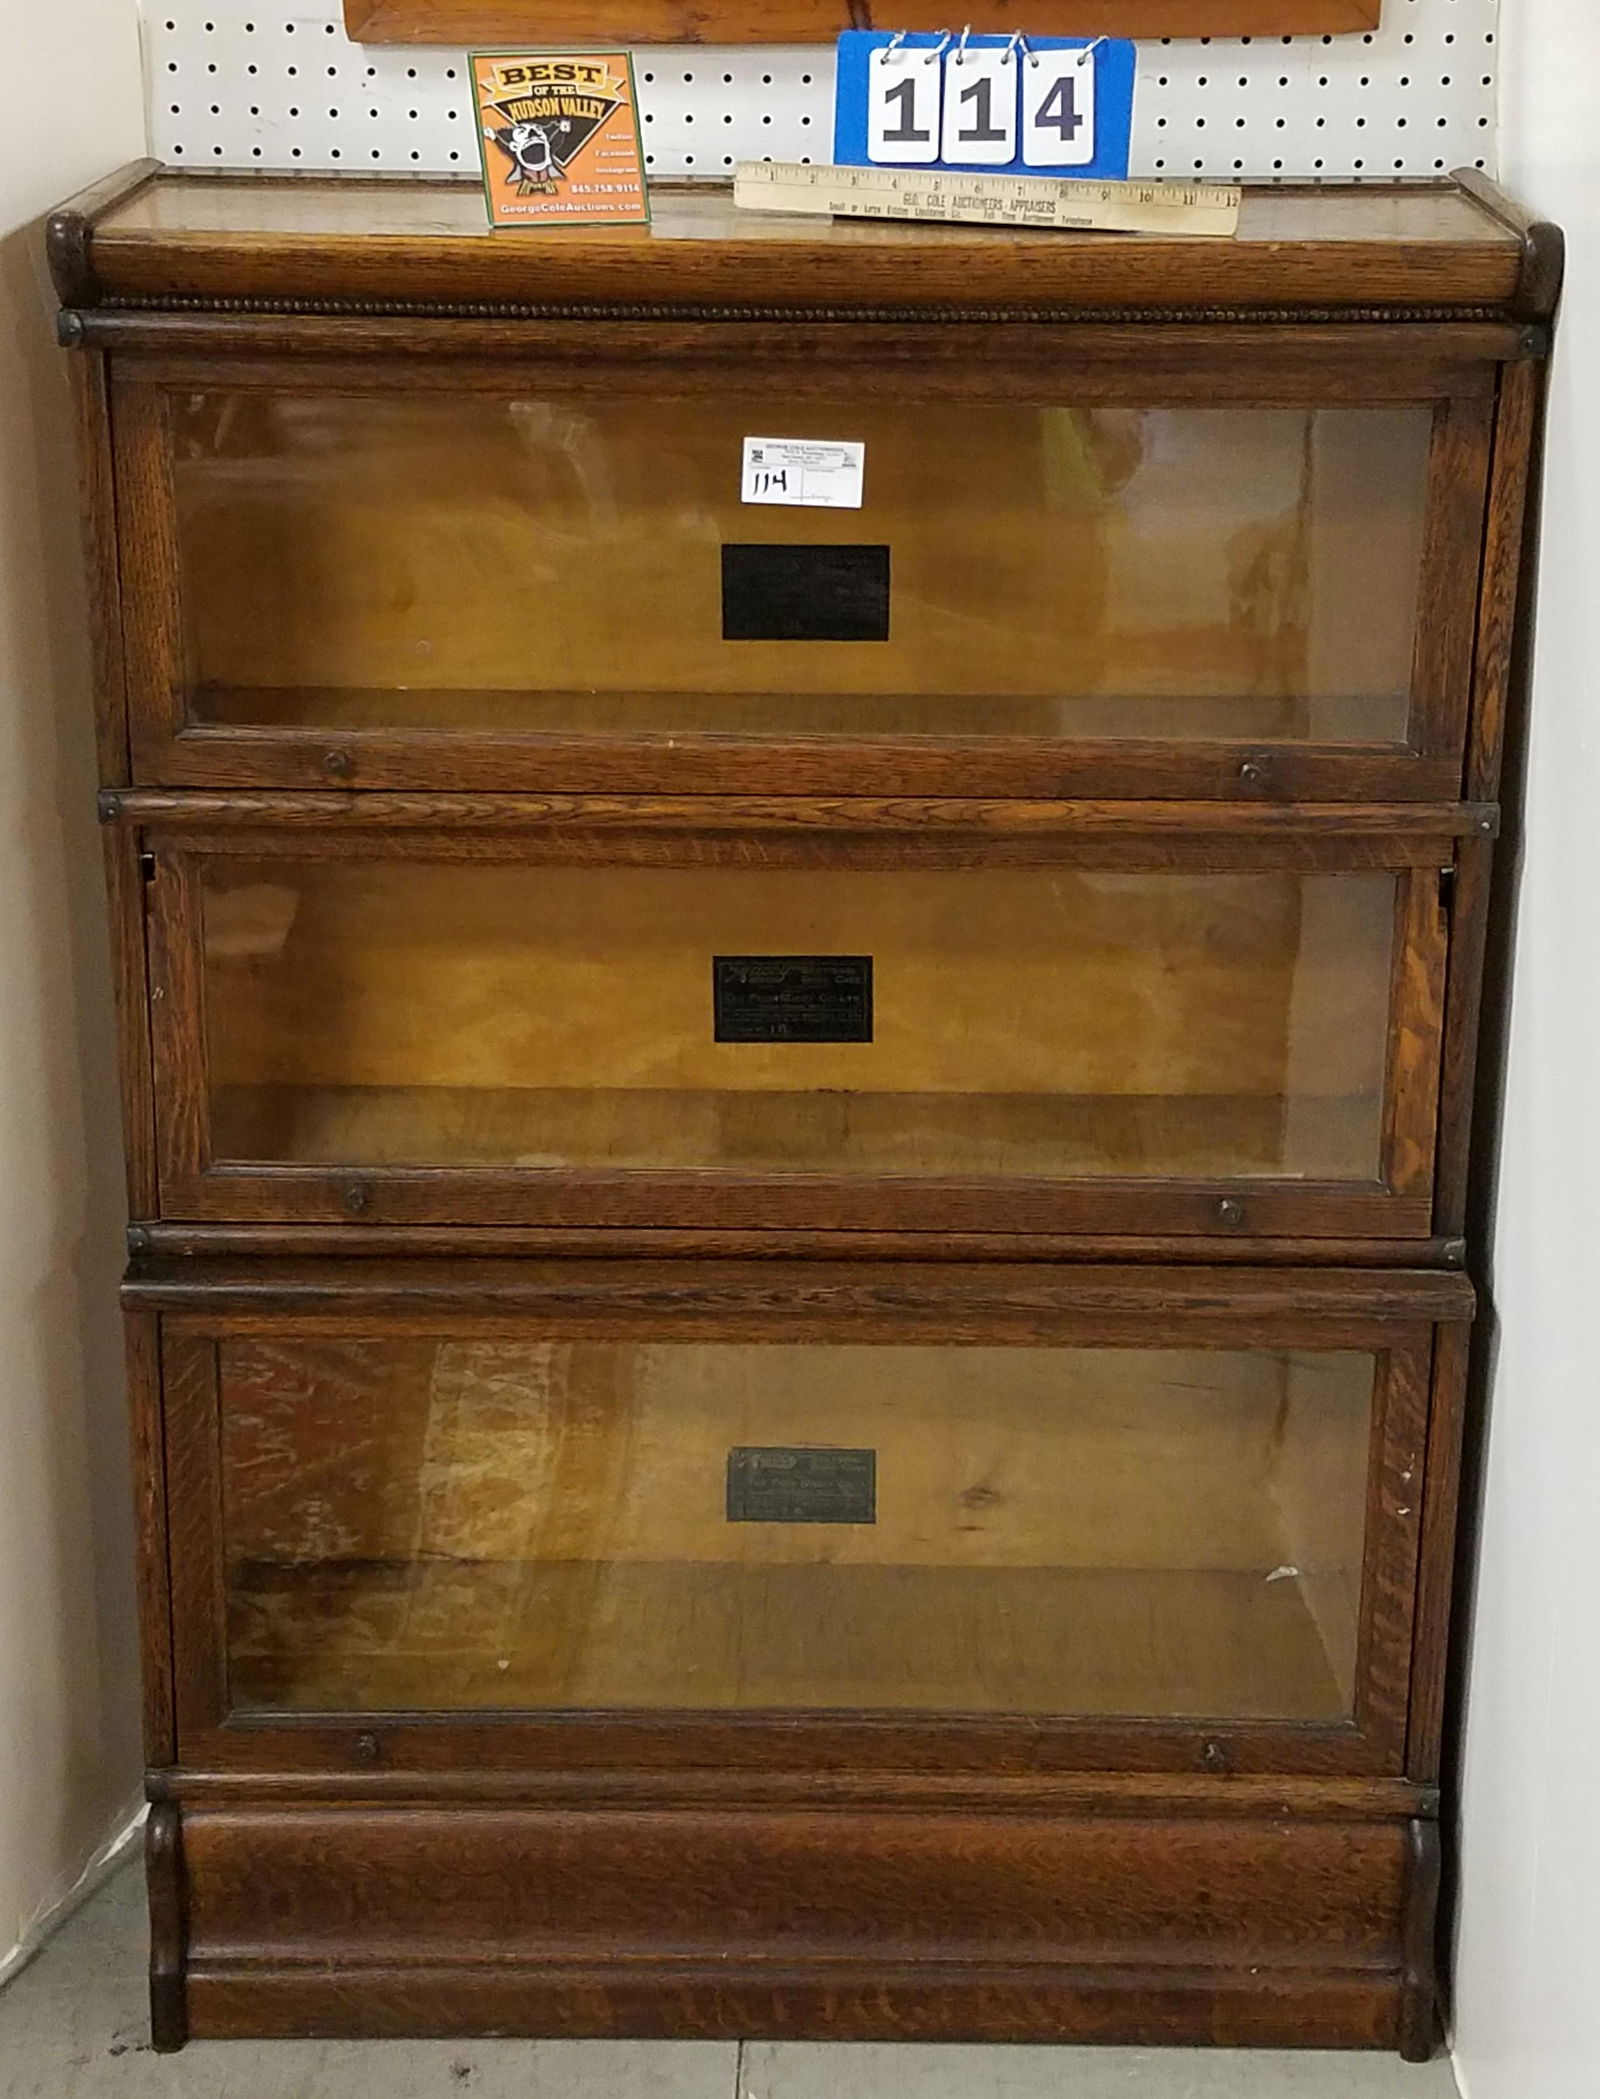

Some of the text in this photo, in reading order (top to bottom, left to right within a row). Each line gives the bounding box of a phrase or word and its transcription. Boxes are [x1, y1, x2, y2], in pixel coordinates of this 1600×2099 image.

[499, 63, 602, 86] BEST
[533, 86, 575, 95] OF THE
[507, 97, 605, 121] HUDSON VALLEY
[927, 194, 945, 207] COLE
[952, 195, 1003, 211] AUCTIONEERS
[1009, 199, 1056, 213] APPRAISERS
[753, 468, 787, 496] 114
